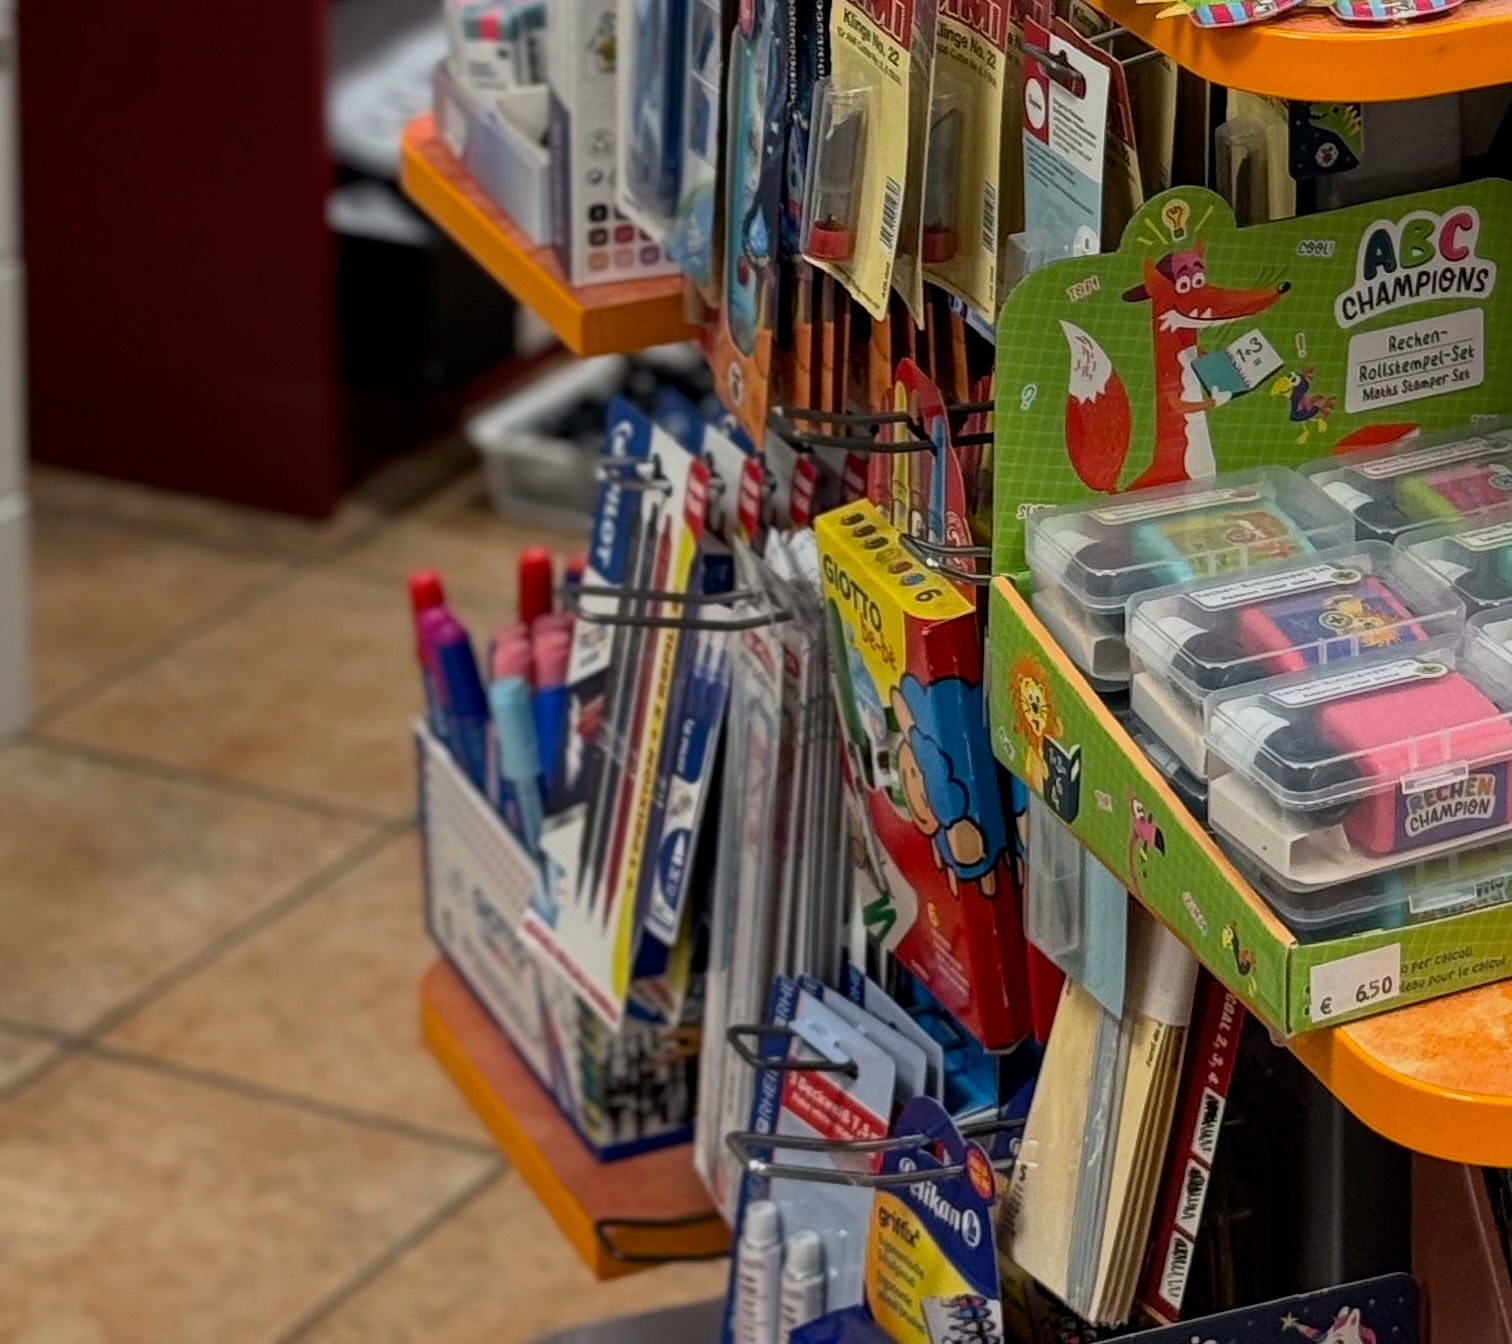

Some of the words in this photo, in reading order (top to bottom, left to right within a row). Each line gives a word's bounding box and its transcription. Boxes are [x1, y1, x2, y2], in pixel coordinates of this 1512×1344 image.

[1362, 211, 1474, 282] ABC
[1341, 264, 1489, 322] CHAMPIONS
[1359, 341, 1475, 382] Rollstempel-Set
[1388, 328, 1448, 354] Rechen-
[1362, 383, 1397, 403] Maths
[1400, 374, 1450, 398] Stamper
[1452, 366, 1472, 386] Set
[823, 553, 883, 634] GIOTTO
[1407, 774, 1495, 817] RECHEN
[1409, 798, 1491, 835] CHAMPION
[1319, 996, 1332, 1015] €
[905, 1174, 962, 1233] elikan
